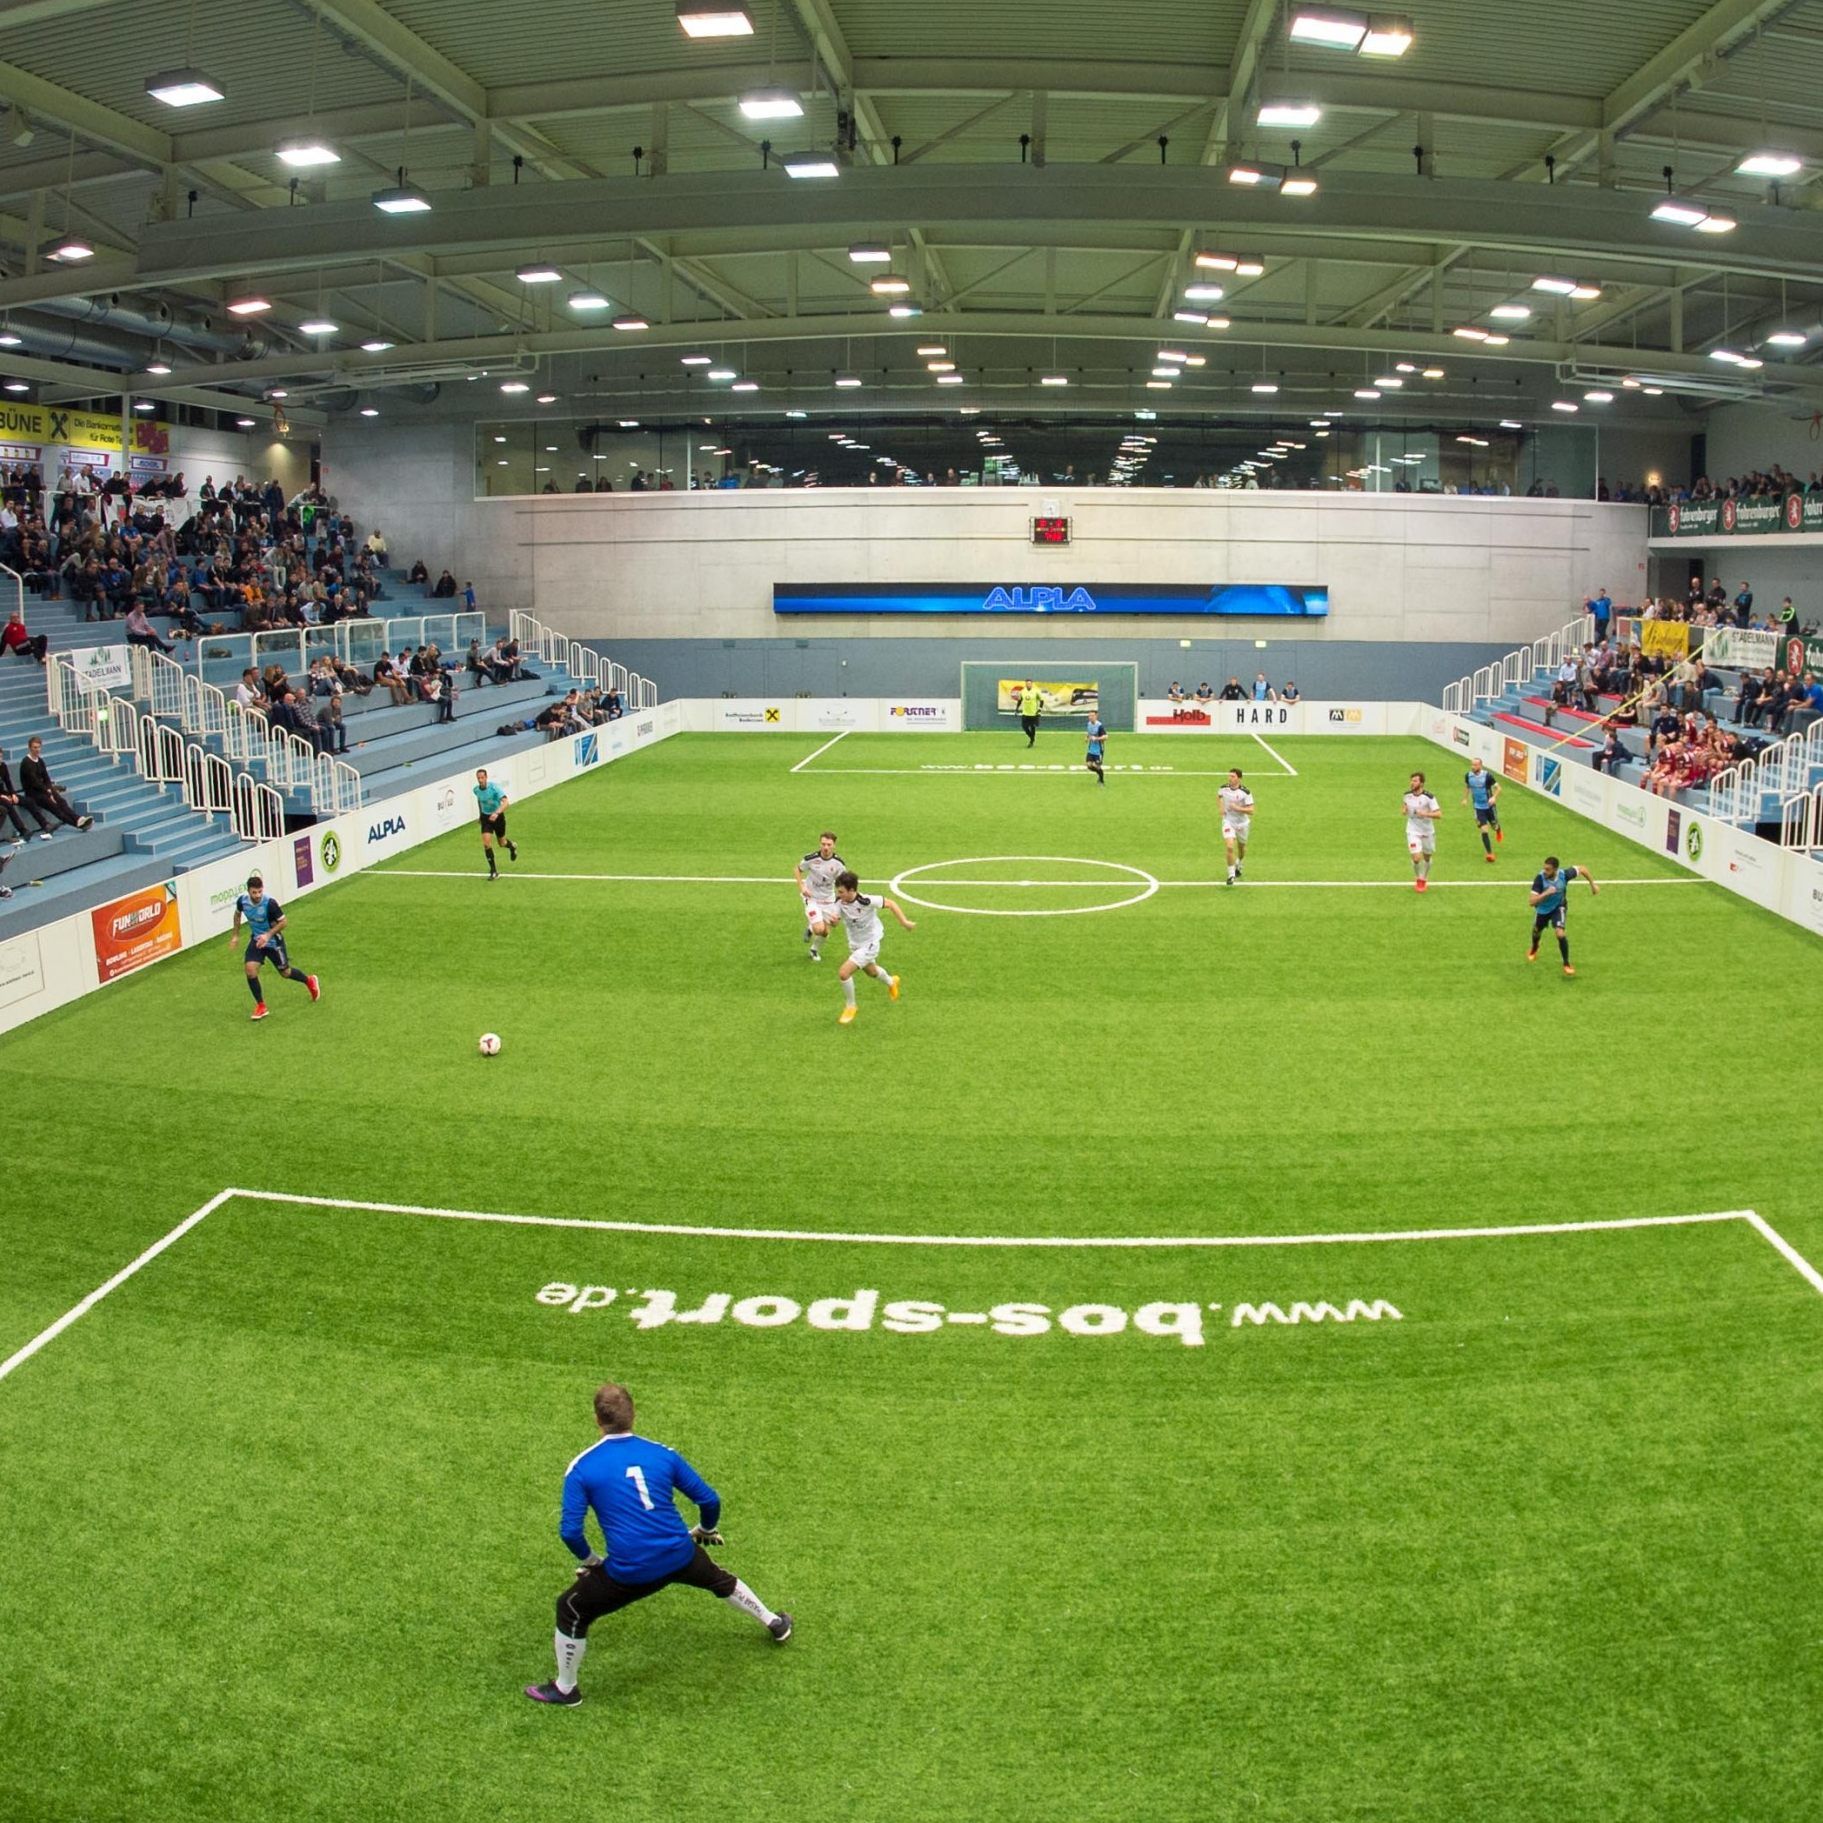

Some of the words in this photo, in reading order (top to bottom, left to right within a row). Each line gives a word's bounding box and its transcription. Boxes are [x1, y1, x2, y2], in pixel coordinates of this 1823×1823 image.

[983, 586, 1096, 610] ALPLA
[1236, 708, 1288, 724] HARD
[367, 815, 406, 844] ALPLA
[535, 1280, 1404, 1346] www.bos-sport.de
[625, 1465, 655, 1511] 1
